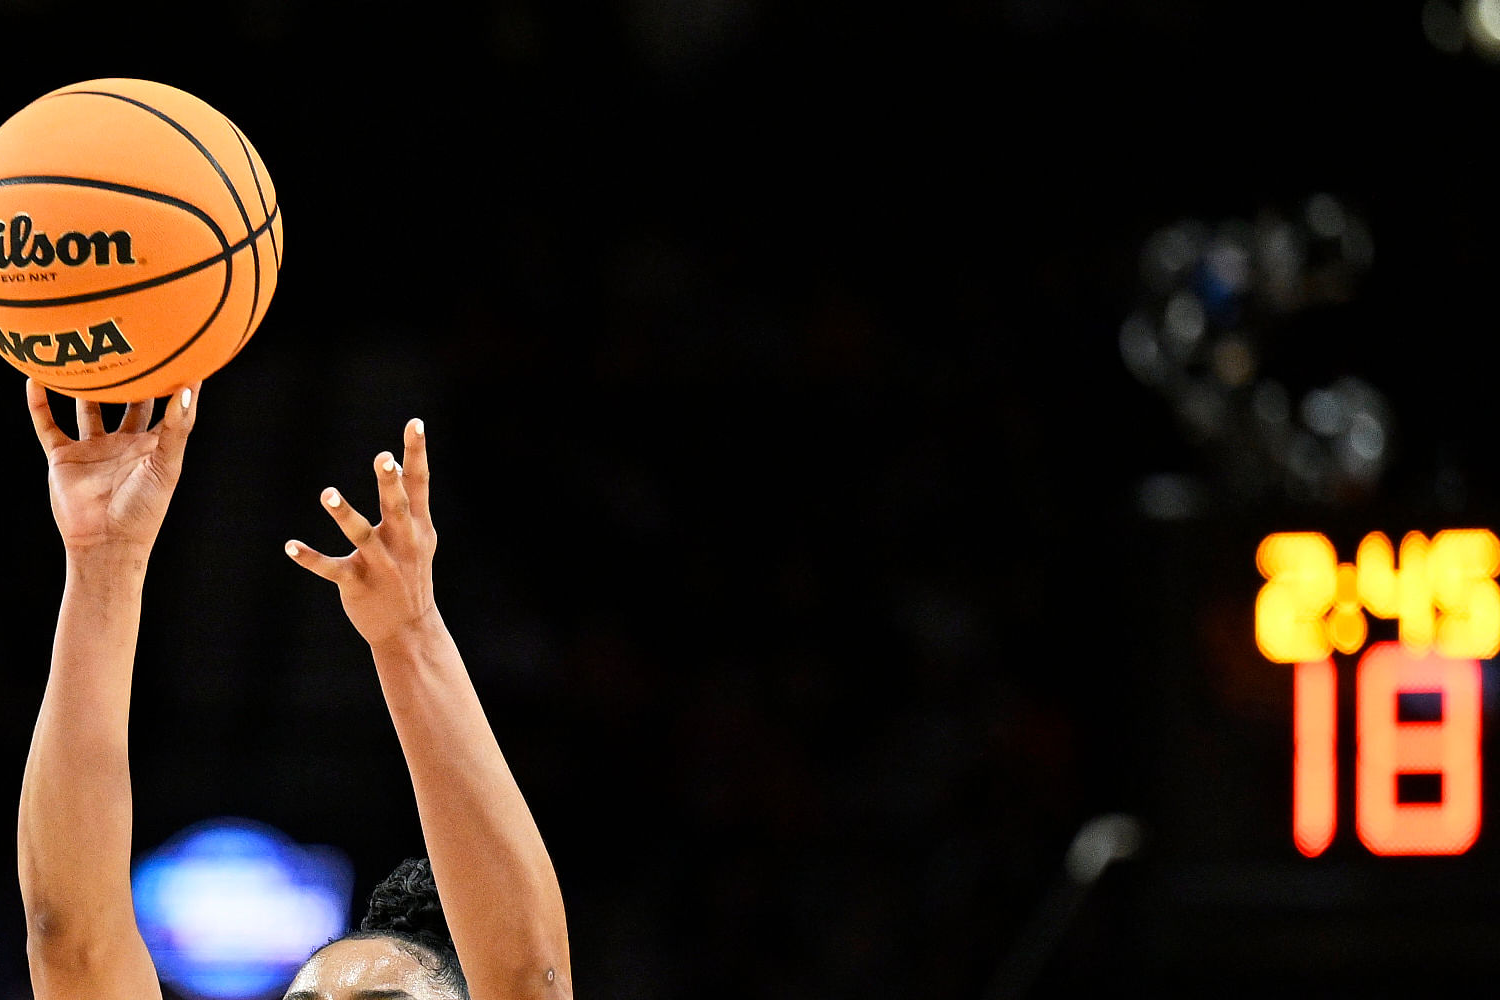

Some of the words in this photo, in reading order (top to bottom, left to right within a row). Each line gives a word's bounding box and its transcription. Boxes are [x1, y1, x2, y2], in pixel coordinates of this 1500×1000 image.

[0, 274, 25, 283] EVO
[29, 272, 58, 281] NXT
[1255, 528, 1500, 664] 2:45
[1293, 639, 1483, 858] 18
